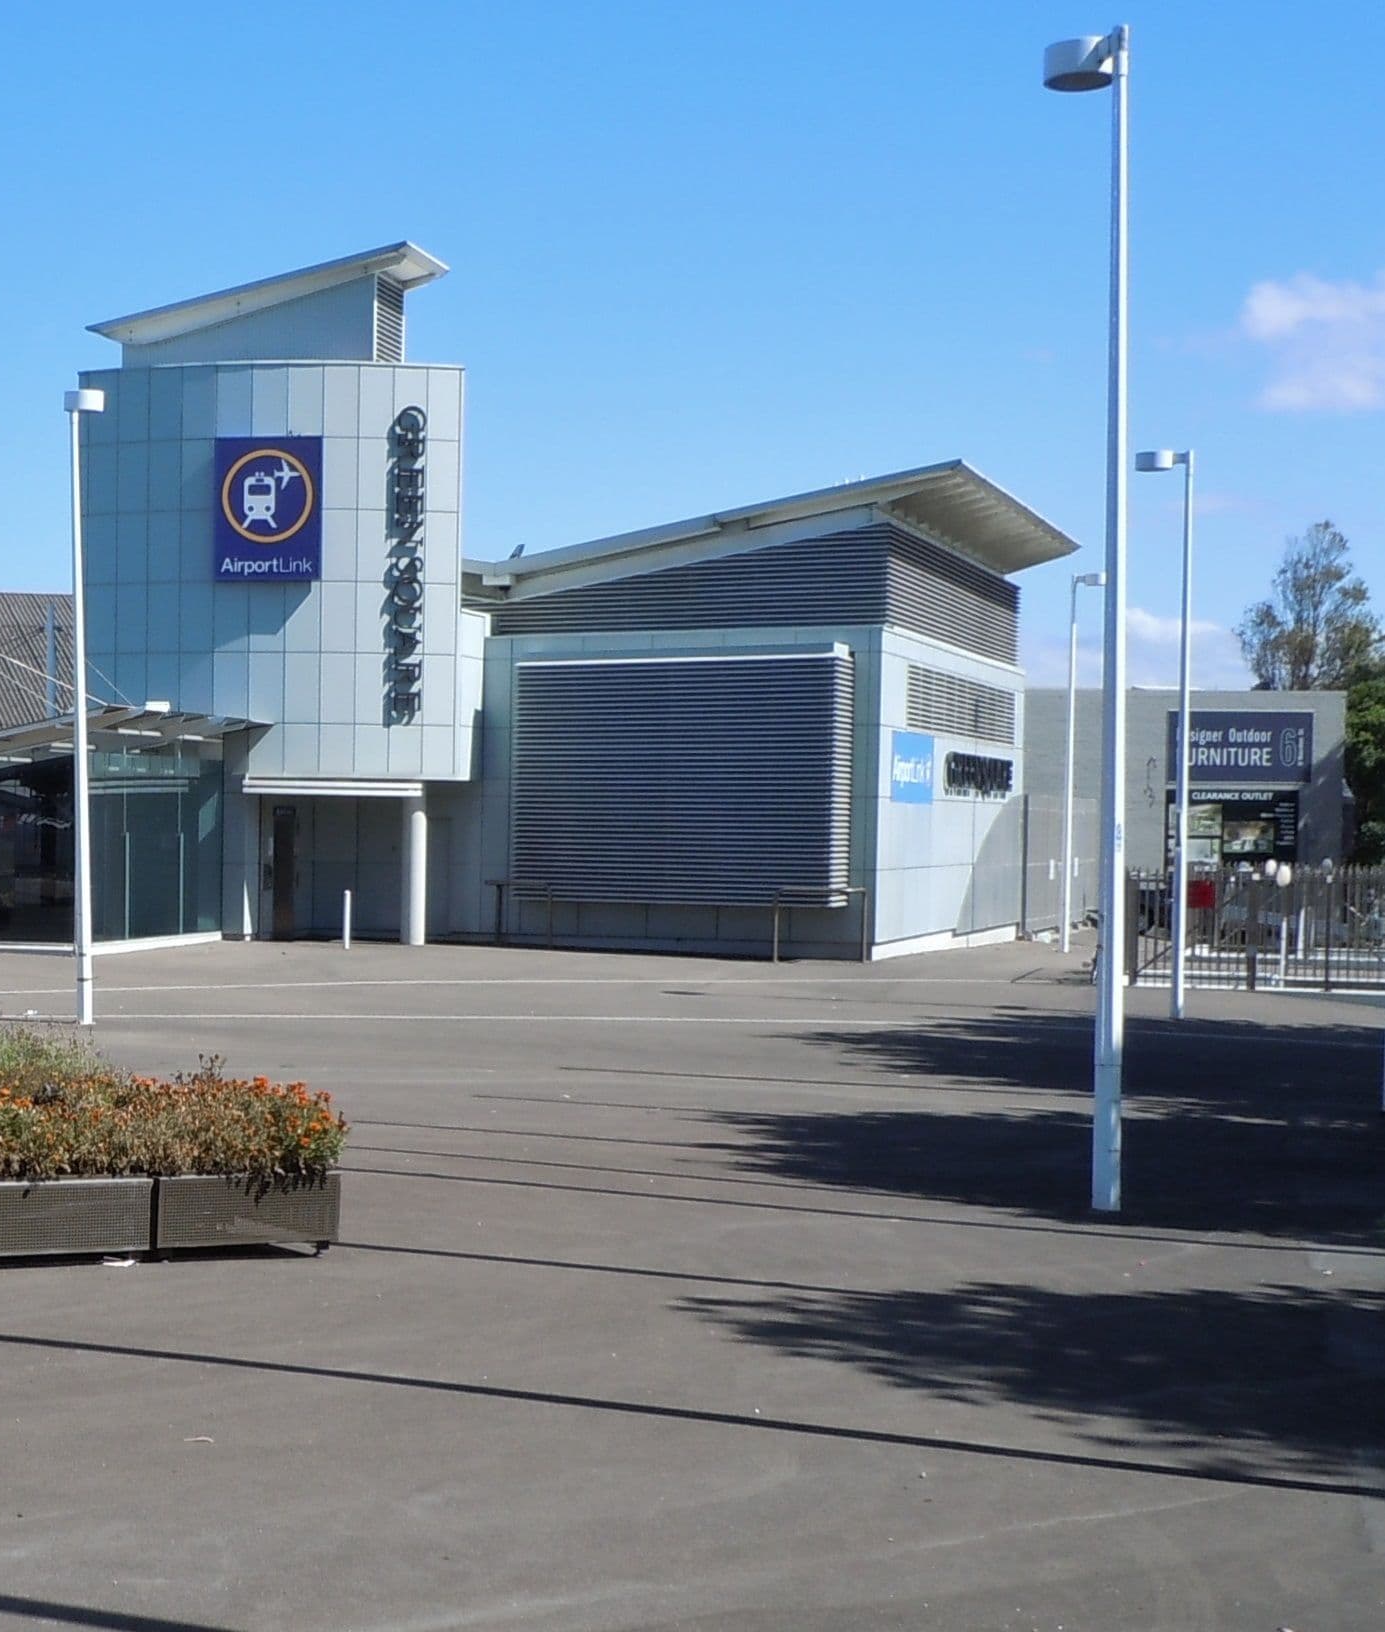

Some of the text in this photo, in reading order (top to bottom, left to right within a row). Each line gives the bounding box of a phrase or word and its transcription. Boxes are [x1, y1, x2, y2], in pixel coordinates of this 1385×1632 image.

[220, 557, 313, 576] AirportLink
[392, 406, 427, 726] GREEN SQUARE
[1177, 729, 1223, 745] signer
[1228, 728, 1272, 743] Outdoor
[1177, 747, 1273, 766] URNITURE
[1191, 792, 1274, 801] CLEARANCE OUTLET
